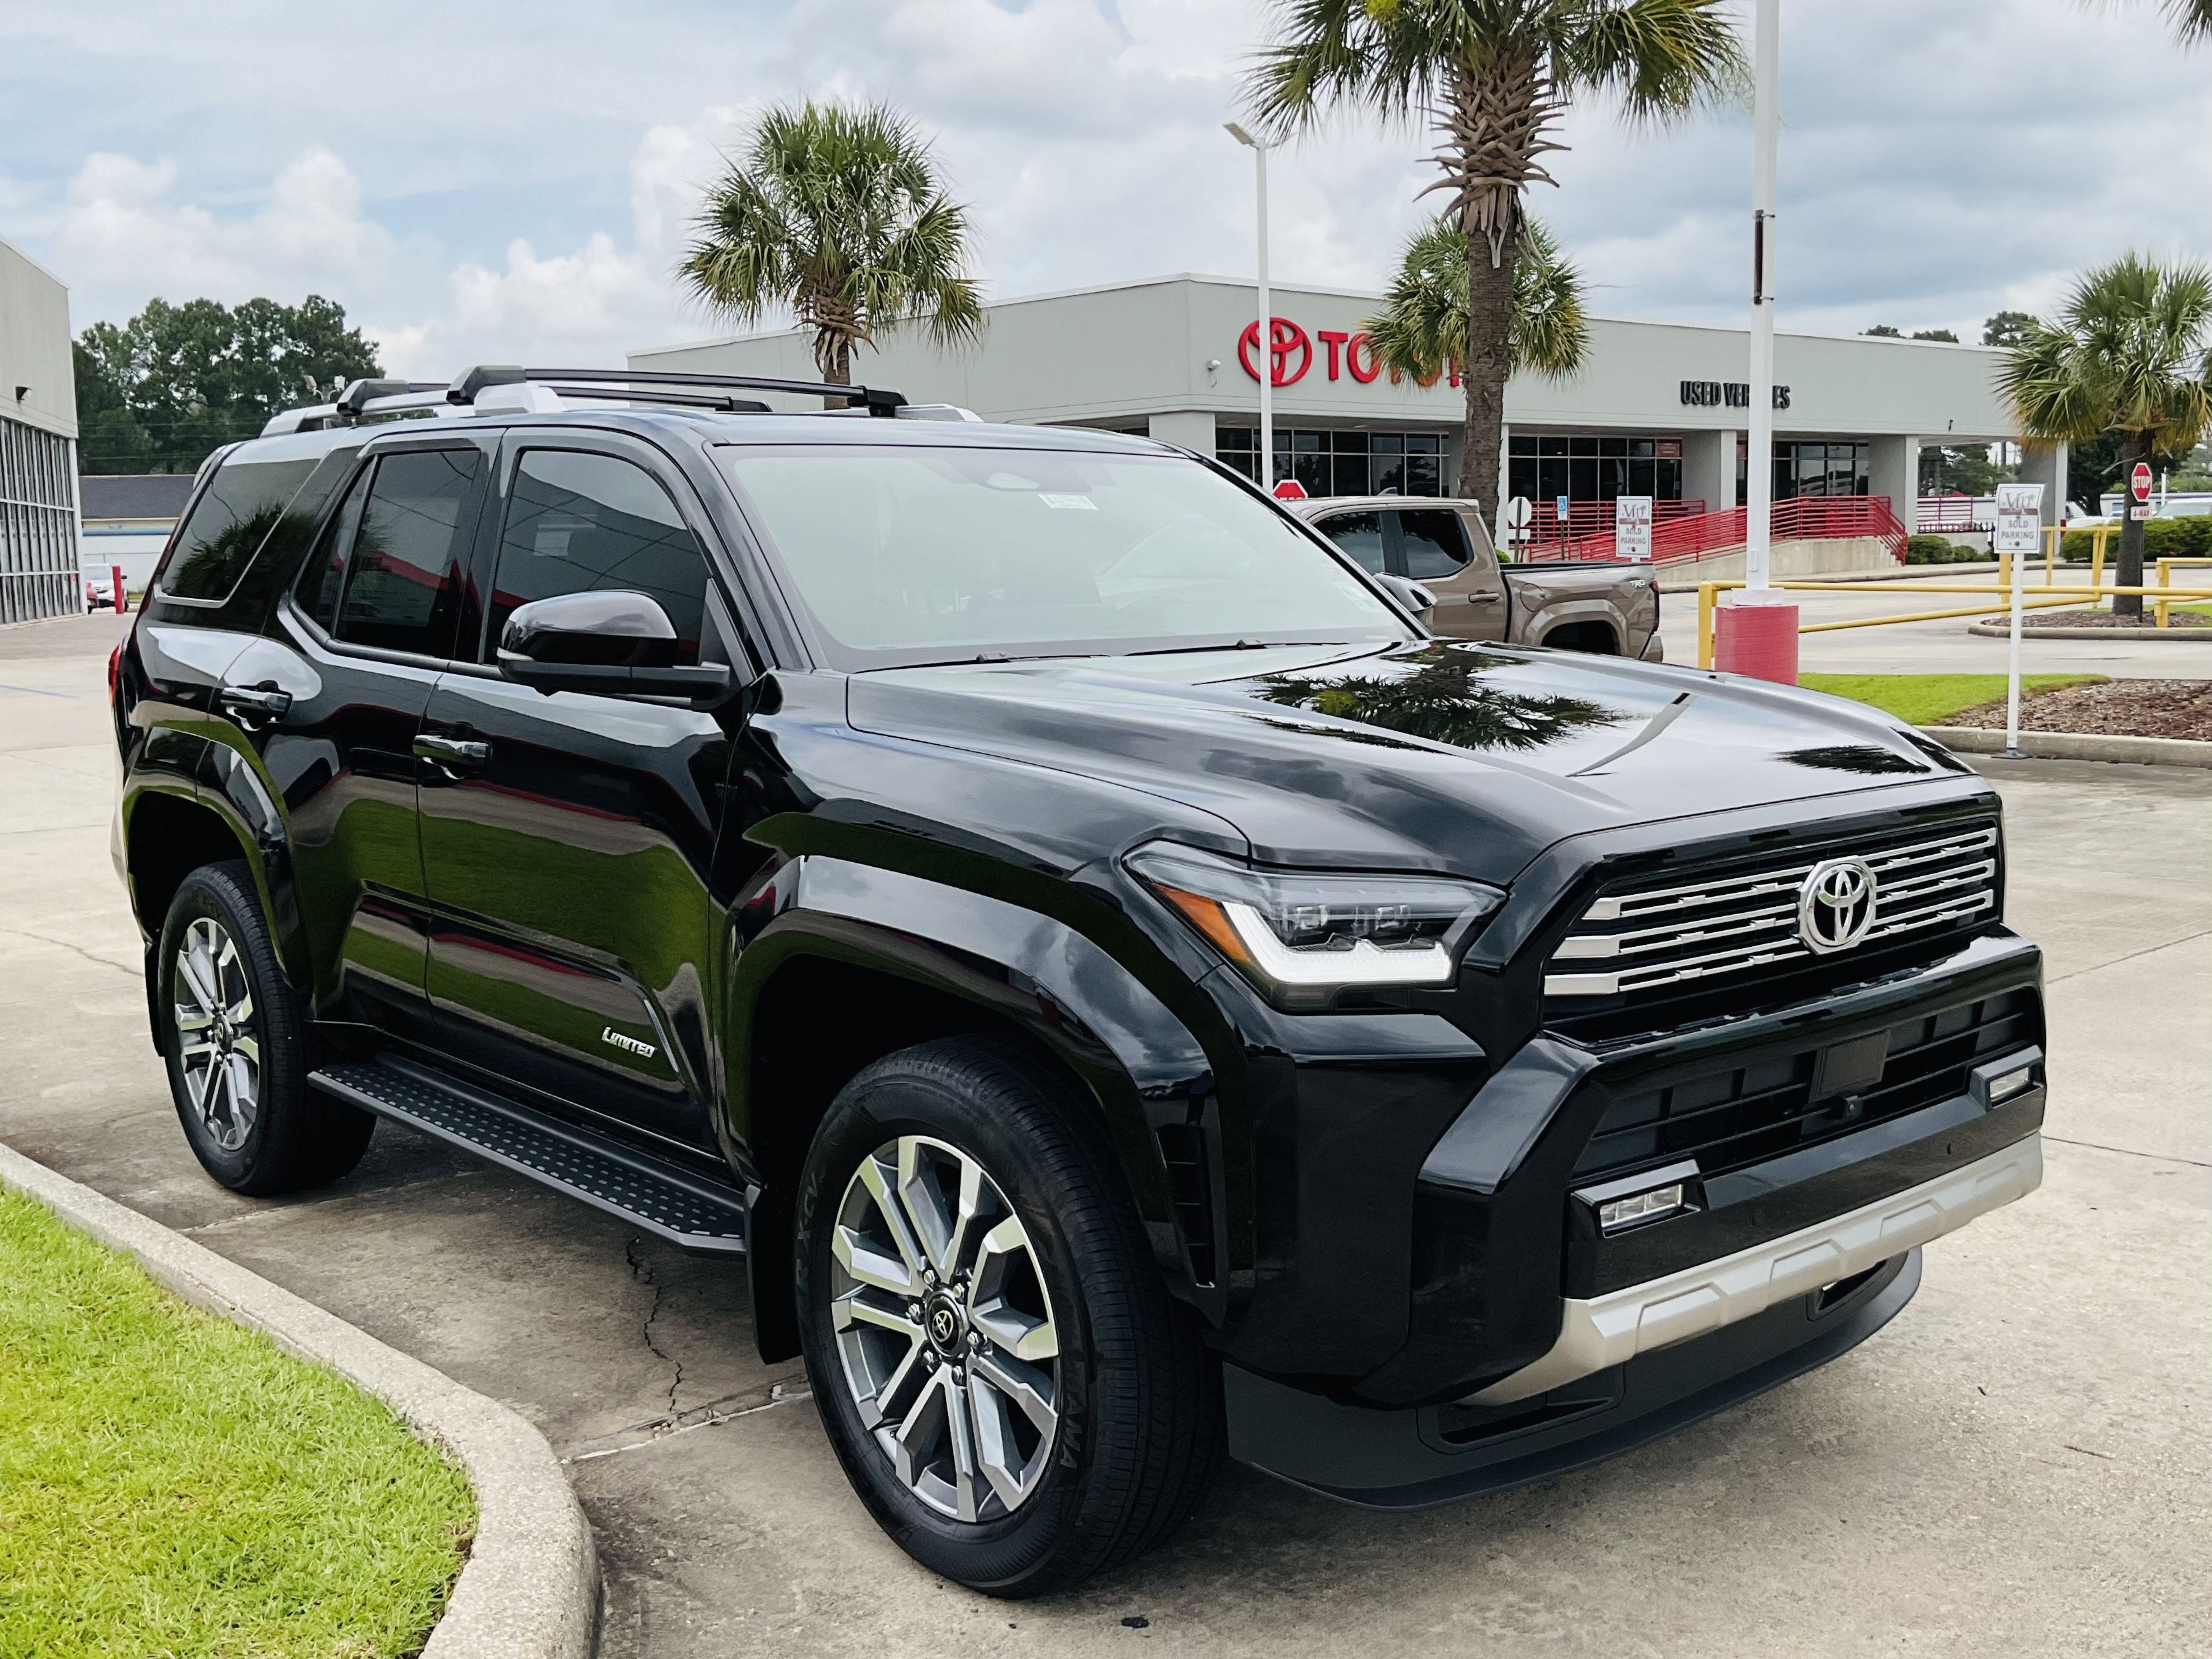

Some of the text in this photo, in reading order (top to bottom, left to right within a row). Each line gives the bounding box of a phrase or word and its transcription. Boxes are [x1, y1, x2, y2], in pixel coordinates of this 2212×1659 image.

[1680, 380, 1791, 409] USED VEHES
[2133, 475, 2151, 489] STOP
[2133, 509, 2150, 517] 4-WAY
[2008, 519, 2028, 528] SOLD
[2001, 531, 2034, 539] PARKING
[1621, 537, 1646, 545] PARKING
